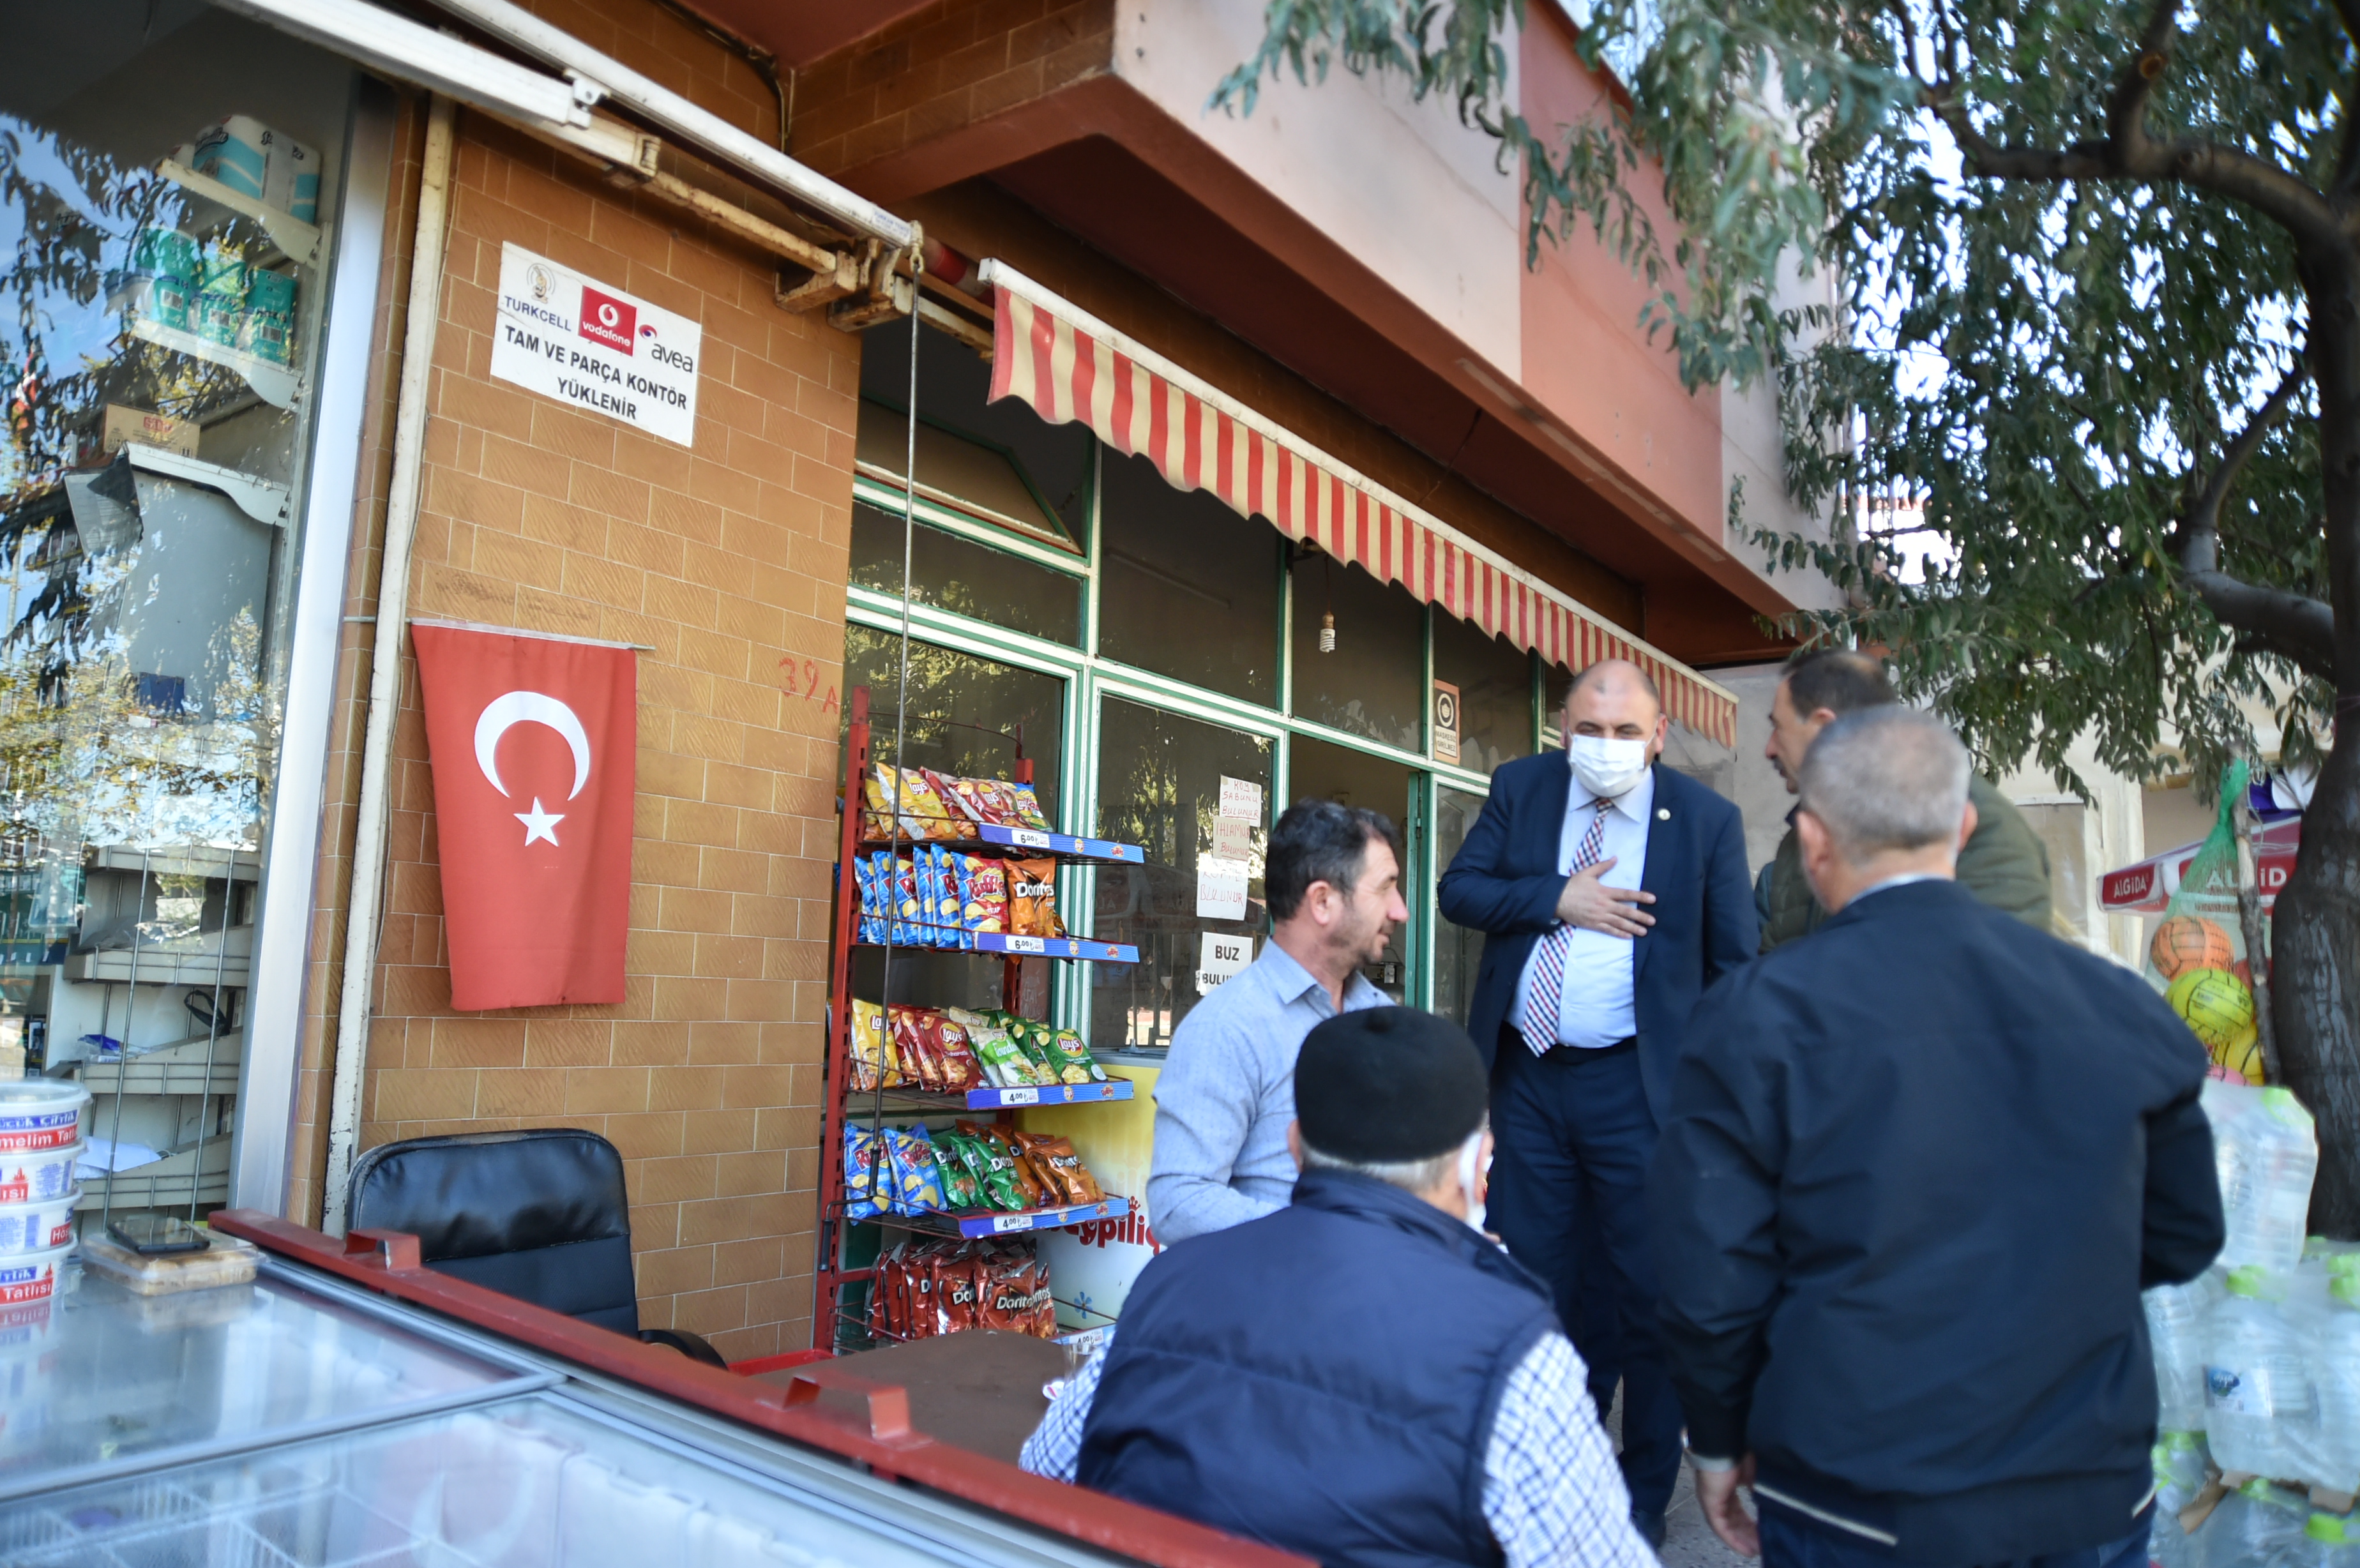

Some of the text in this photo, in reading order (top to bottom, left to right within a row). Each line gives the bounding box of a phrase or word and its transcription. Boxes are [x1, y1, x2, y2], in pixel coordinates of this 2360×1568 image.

[504, 296, 571, 331] TURKCELL
[582, 320, 631, 347] vodafone
[505, 325, 687, 410] TAM VE PARÇA KONTÖR
[651, 343, 693, 373] avea
[557, 377, 637, 420] YÜKLENİR
[1222, 791, 1258, 804] SABUNU
[1222, 805, 1260, 818] BULUNUR
[1215, 945, 1239, 961] BUZ
[1202, 973, 1232, 985] BULU
[3, 1283, 51, 1301] Tatlısı
